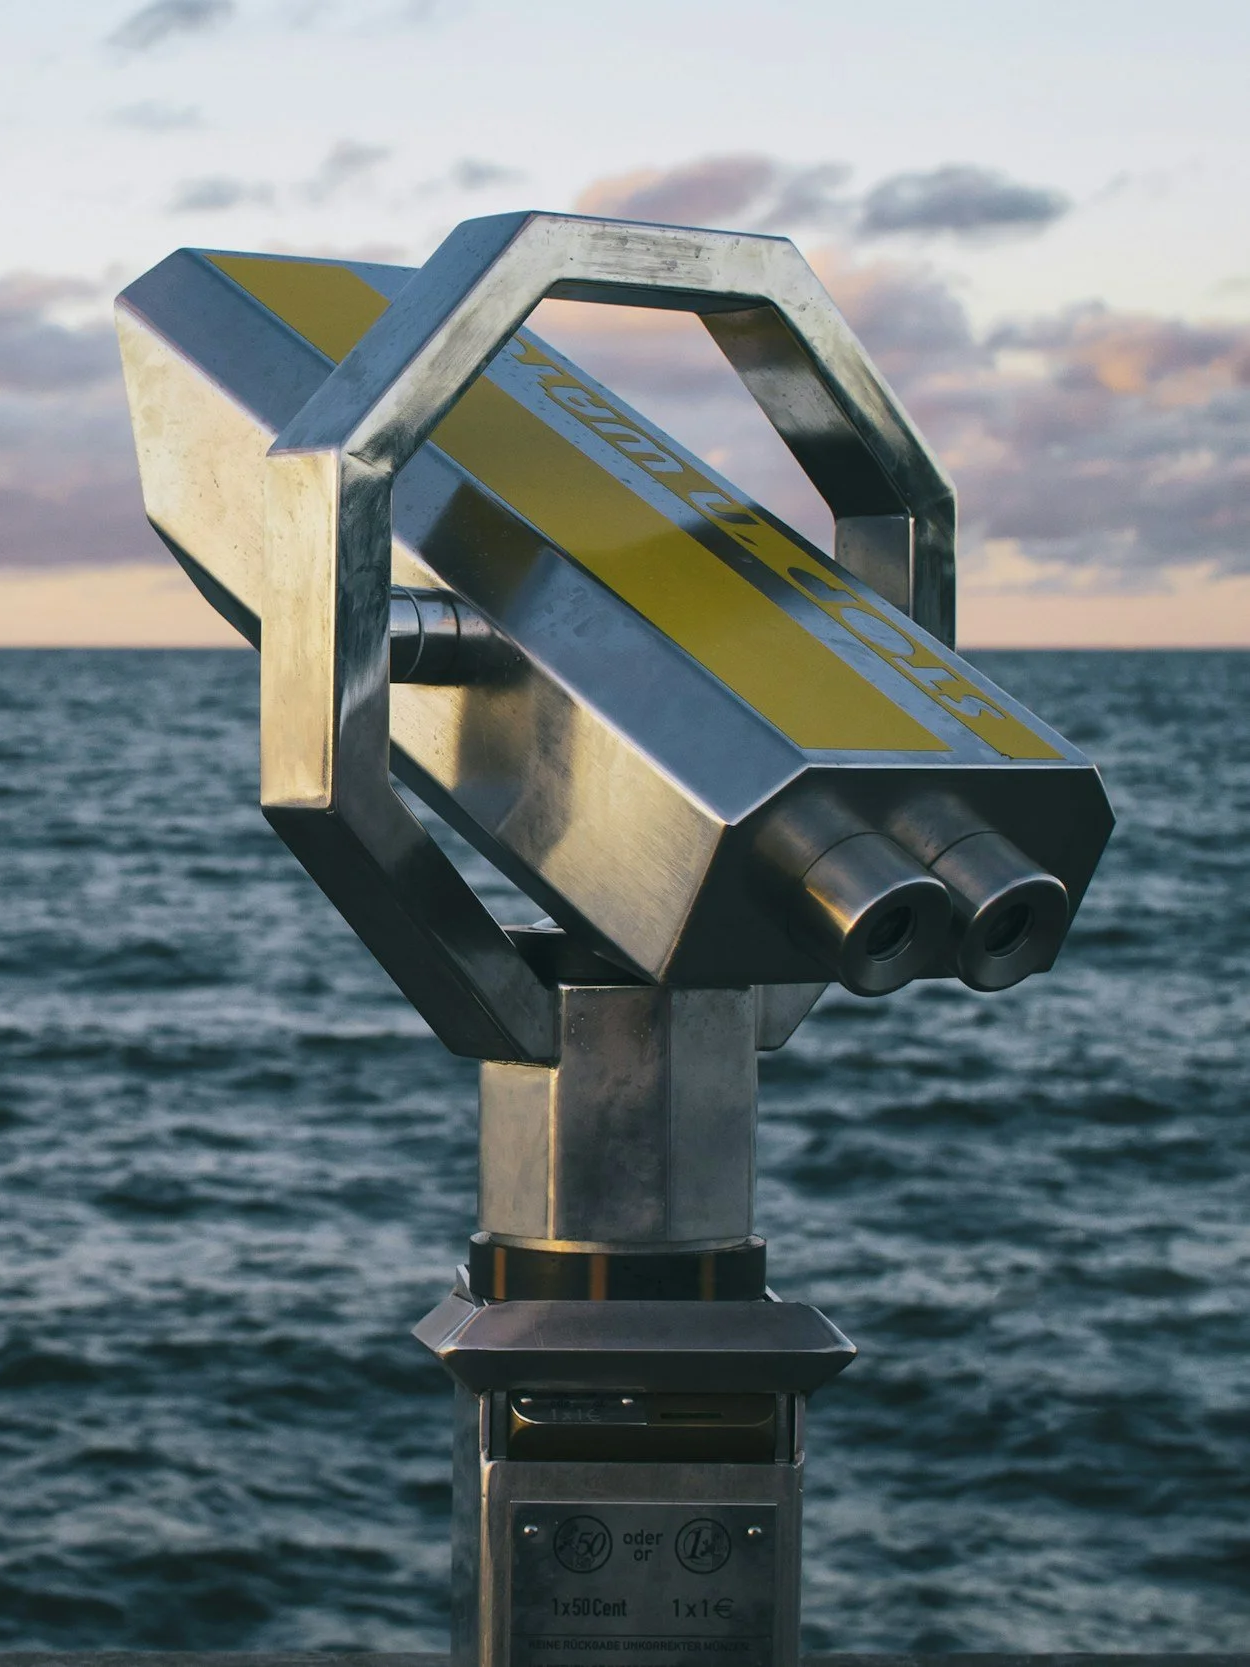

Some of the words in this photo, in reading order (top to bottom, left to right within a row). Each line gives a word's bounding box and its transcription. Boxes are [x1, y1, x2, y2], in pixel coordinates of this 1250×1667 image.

[787, 567, 1007, 720] STOP
[622, 1529, 664, 1546] oder
[633, 1549, 655, 1562] or
[563, 1638, 619, 1650] RÜCKGABE
